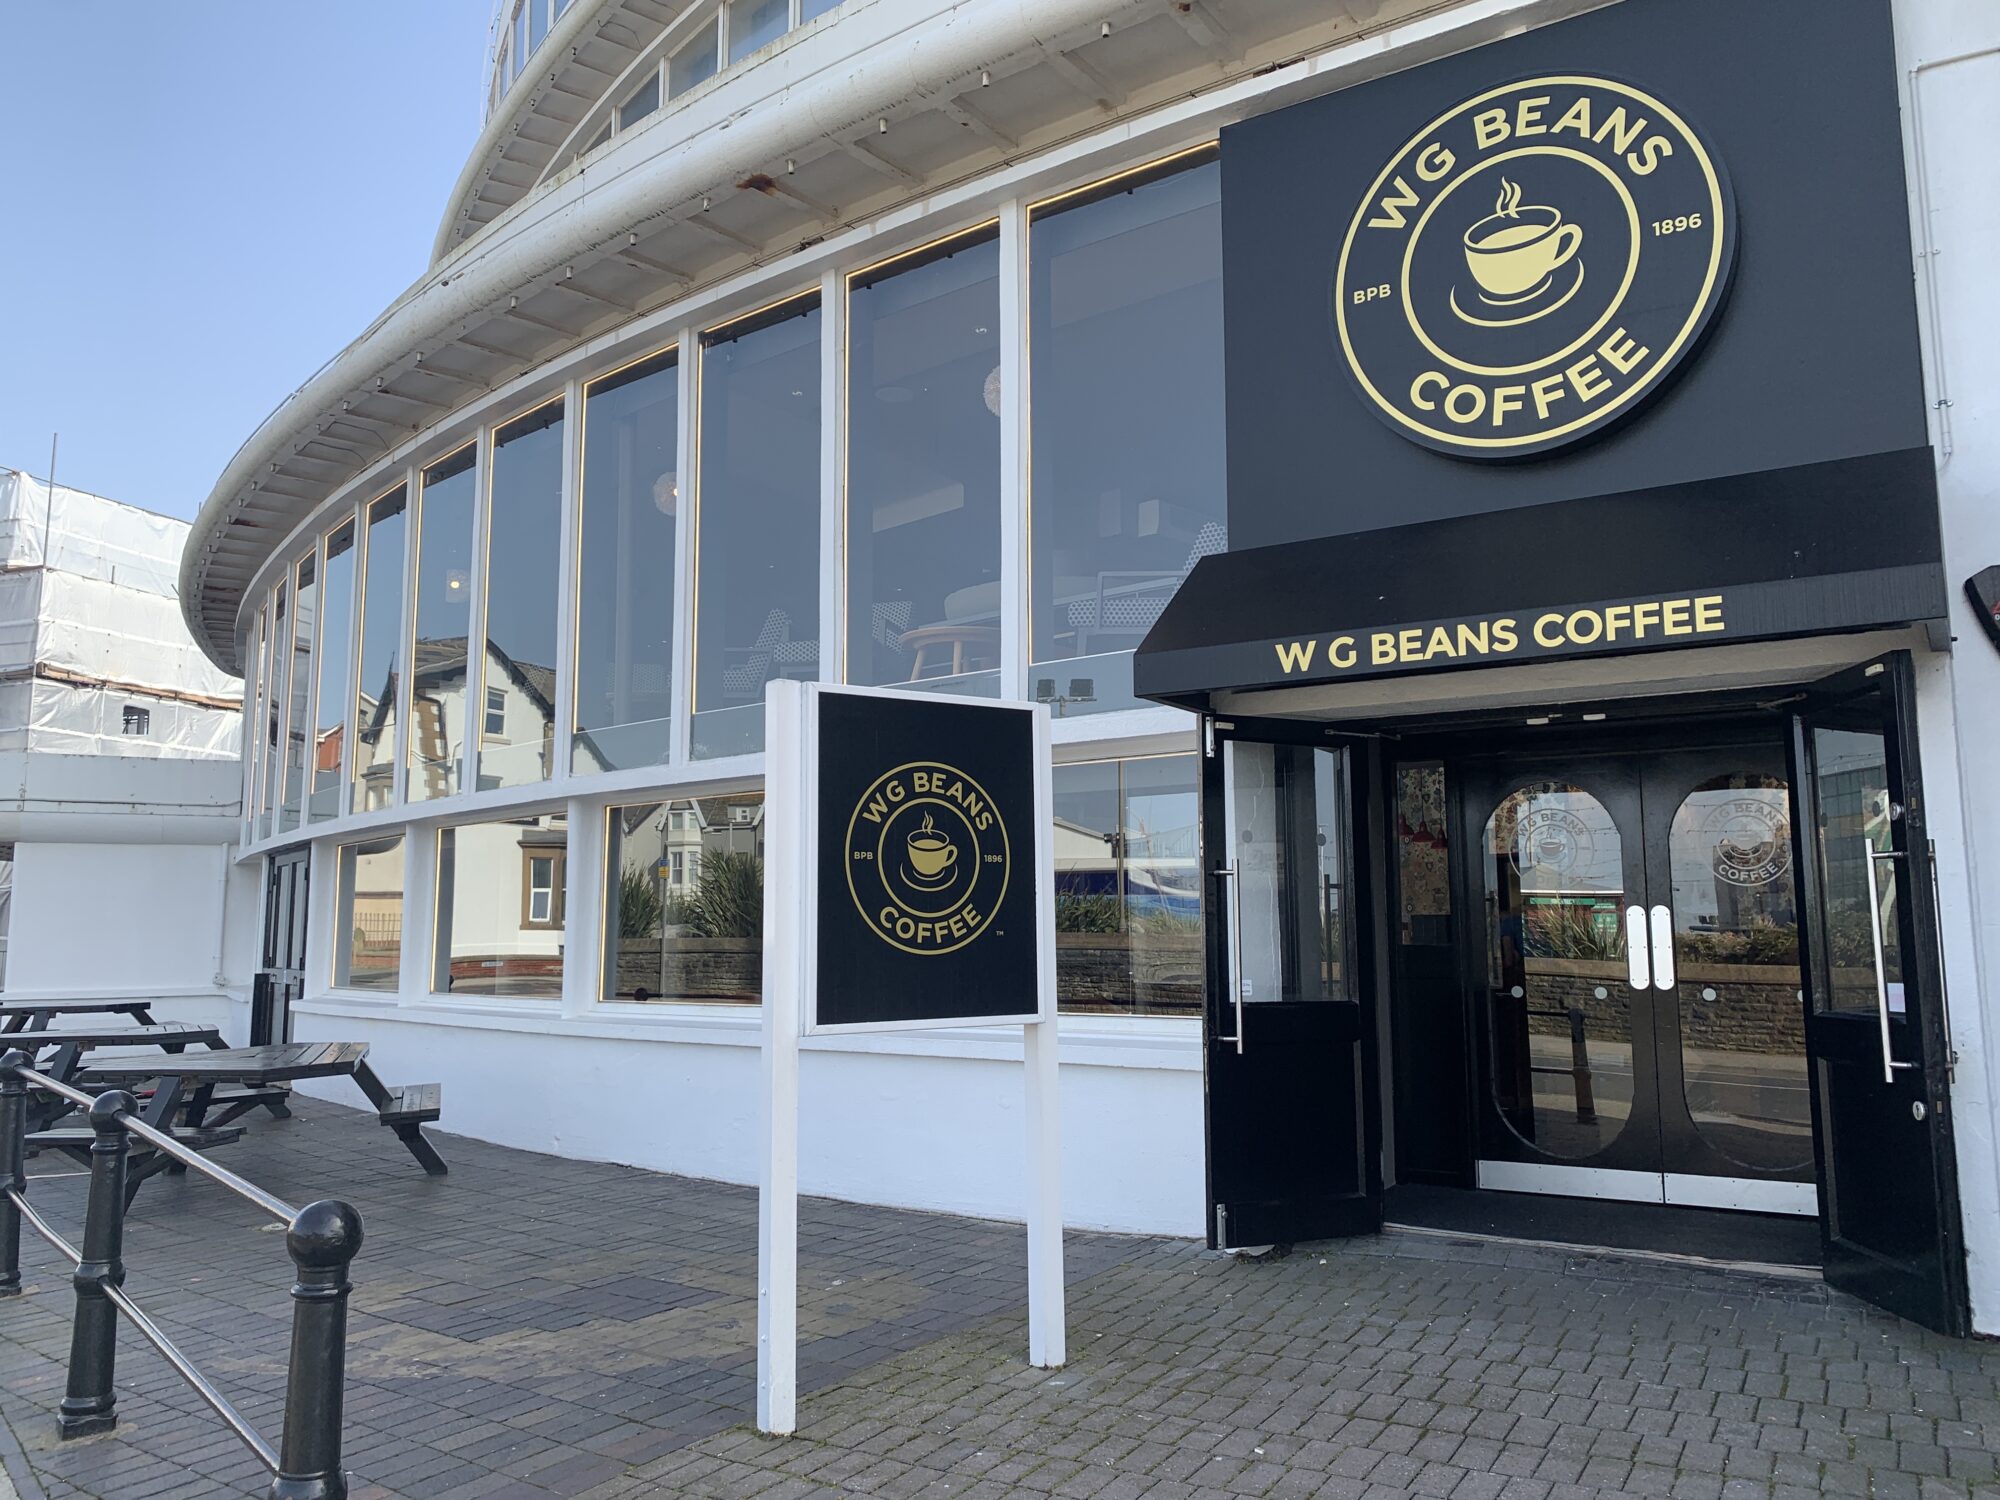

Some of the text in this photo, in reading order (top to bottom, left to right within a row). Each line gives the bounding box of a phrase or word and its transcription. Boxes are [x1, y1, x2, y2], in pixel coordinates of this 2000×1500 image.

[1368, 95, 1674, 229] WG BEANS
[1651, 213, 1702, 237] 1896
[1352, 283, 1392, 305] BPB
[1410, 326, 1650, 427] COFFEE
[1371, 619, 1519, 666] BEANS
[1533, 595, 1725, 649] COFFEE
[862, 771, 993, 831] WG BEANS
[1540, 812, 1585, 836] BEANS
[1734, 802, 1783, 832] BEANS
[854, 850, 874, 860] BPB
[983, 853, 1003, 864] 1896
[1718, 862, 1779, 881] COFFEE
[879, 903, 982, 944] COFFEE
